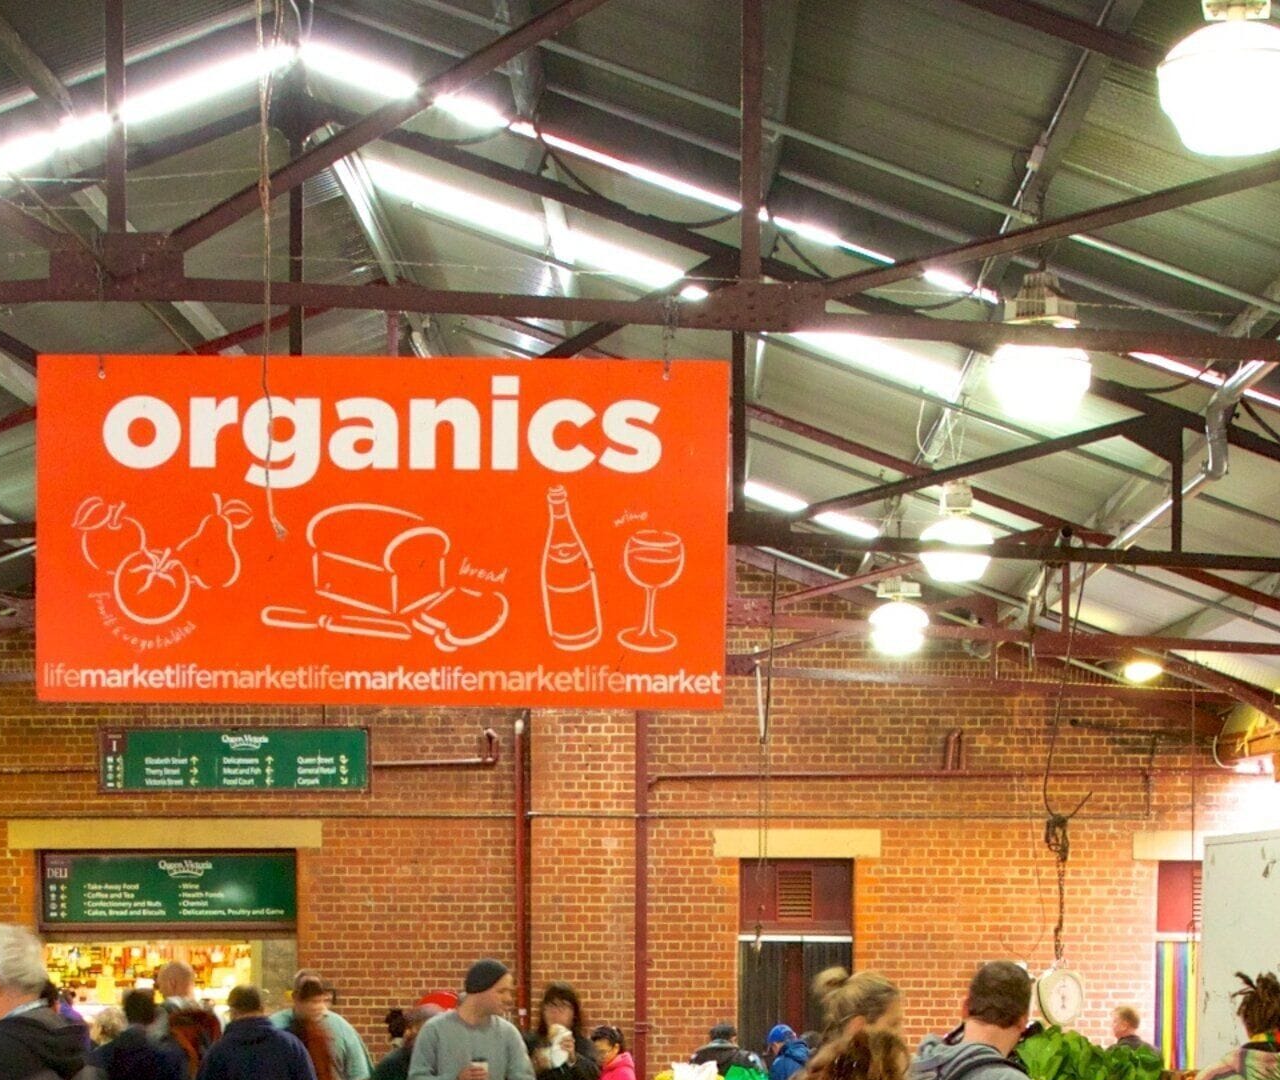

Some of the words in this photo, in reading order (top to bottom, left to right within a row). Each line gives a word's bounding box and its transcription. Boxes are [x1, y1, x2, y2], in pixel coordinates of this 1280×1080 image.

[102, 375, 663, 490] organics
[458, 556, 509, 584] bread
[47, 867, 69, 879] DELI
[122, 883, 140, 891] Food
[87, 891, 109, 899] Coffee
[109, 891, 122, 899] and
[122, 891, 136, 899] Tea
[132, 900, 146, 908] and
[108, 909, 128, 917] Bread
[128, 909, 141, 917] and
[251, 908, 266, 917] and
[266, 908, 285, 917] Game
